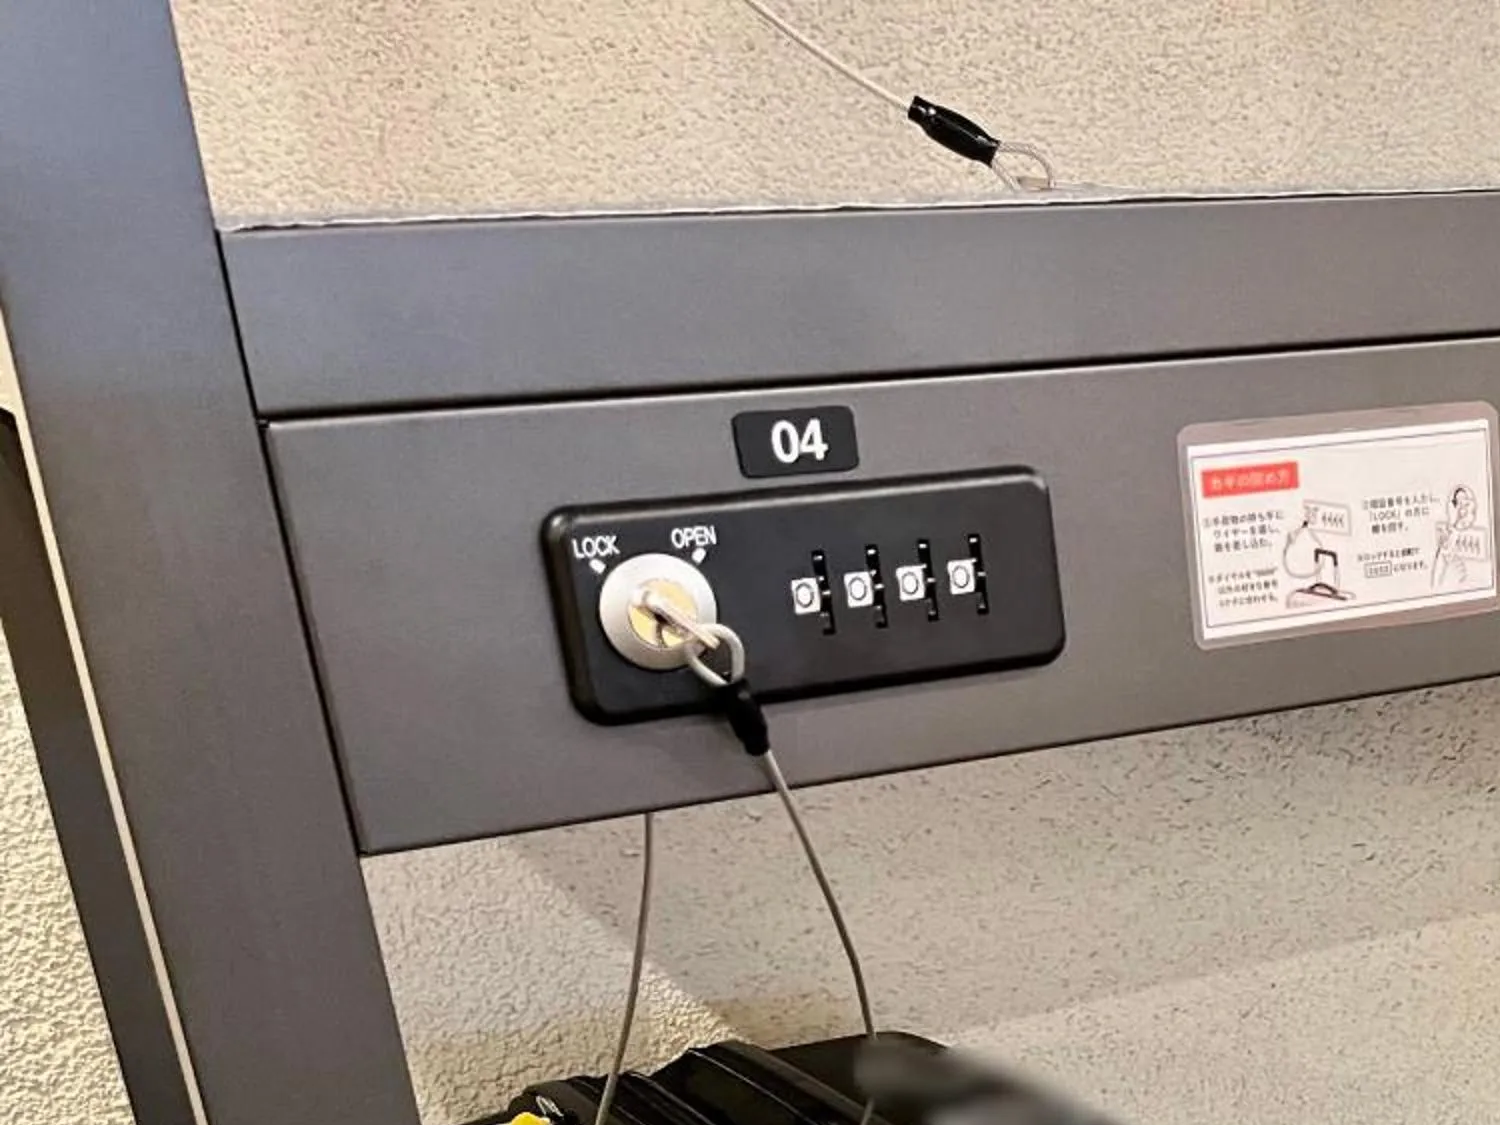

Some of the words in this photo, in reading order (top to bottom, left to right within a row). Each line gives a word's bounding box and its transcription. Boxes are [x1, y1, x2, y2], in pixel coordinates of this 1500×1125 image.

[770, 418, 829, 463] 04
[571, 534, 621, 559] LOCK
[671, 525, 718, 549] OPEN
